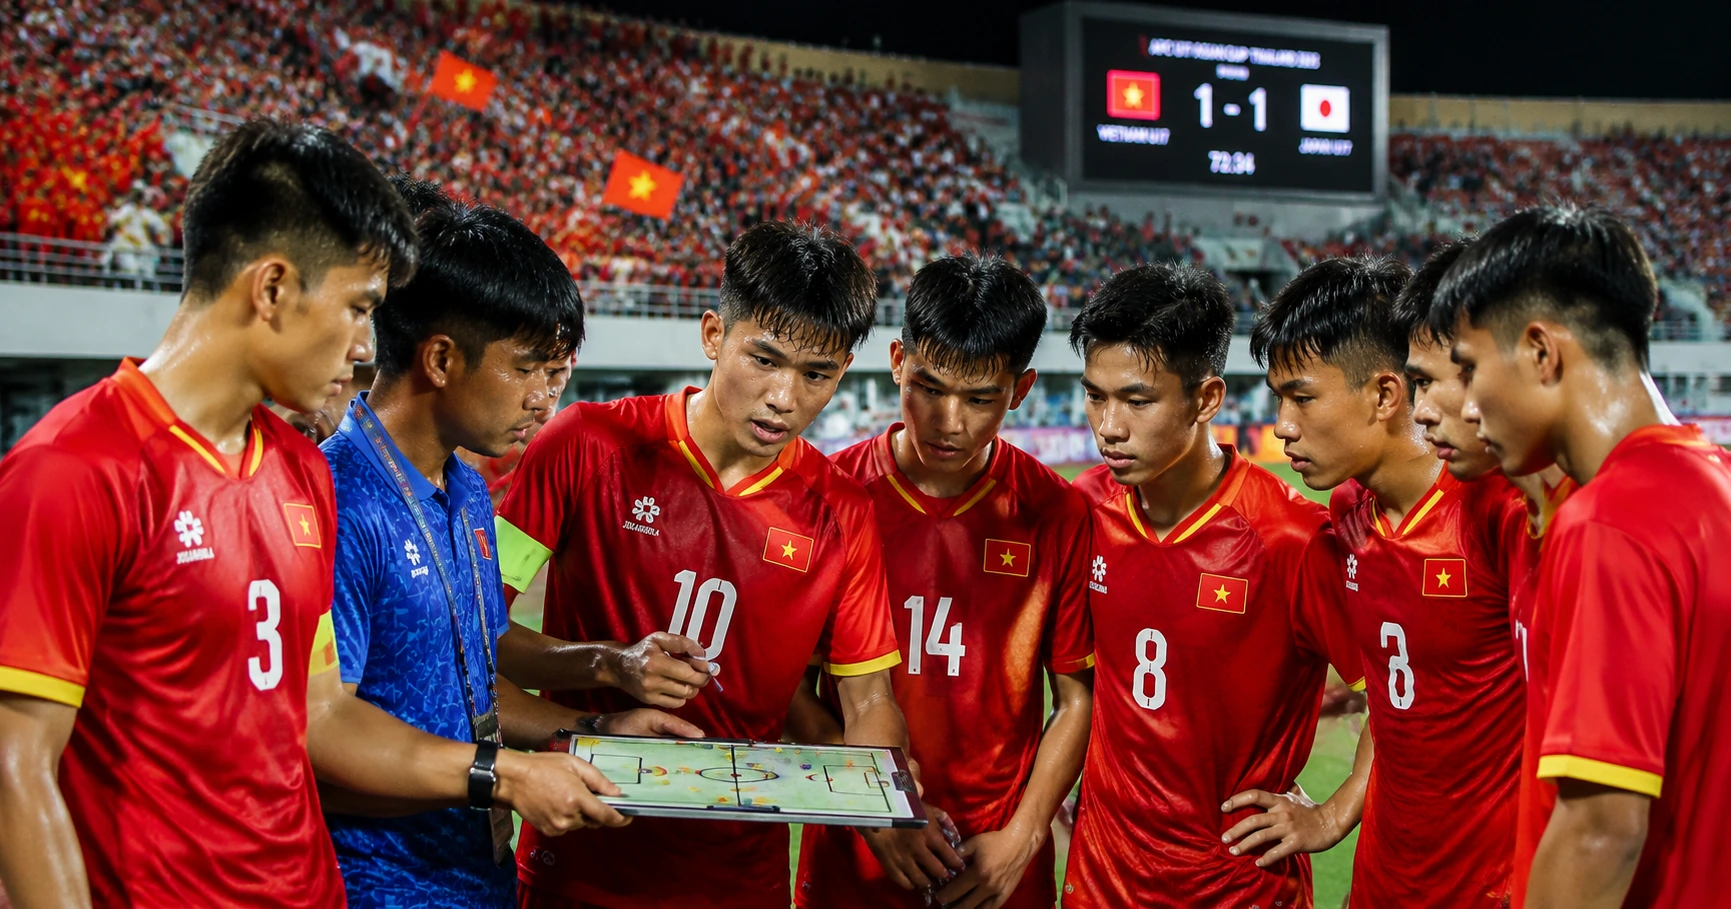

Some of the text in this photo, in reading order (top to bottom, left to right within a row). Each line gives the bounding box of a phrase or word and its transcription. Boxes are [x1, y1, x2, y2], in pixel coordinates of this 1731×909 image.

[1193, 82, 1213, 129] 1
[1248, 87, 1267, 132] 1
[248, 579, 283, 691] 3
[668, 569, 737, 662] 10
[904, 595, 966, 676] 14
[1132, 628, 1168, 710] 8
